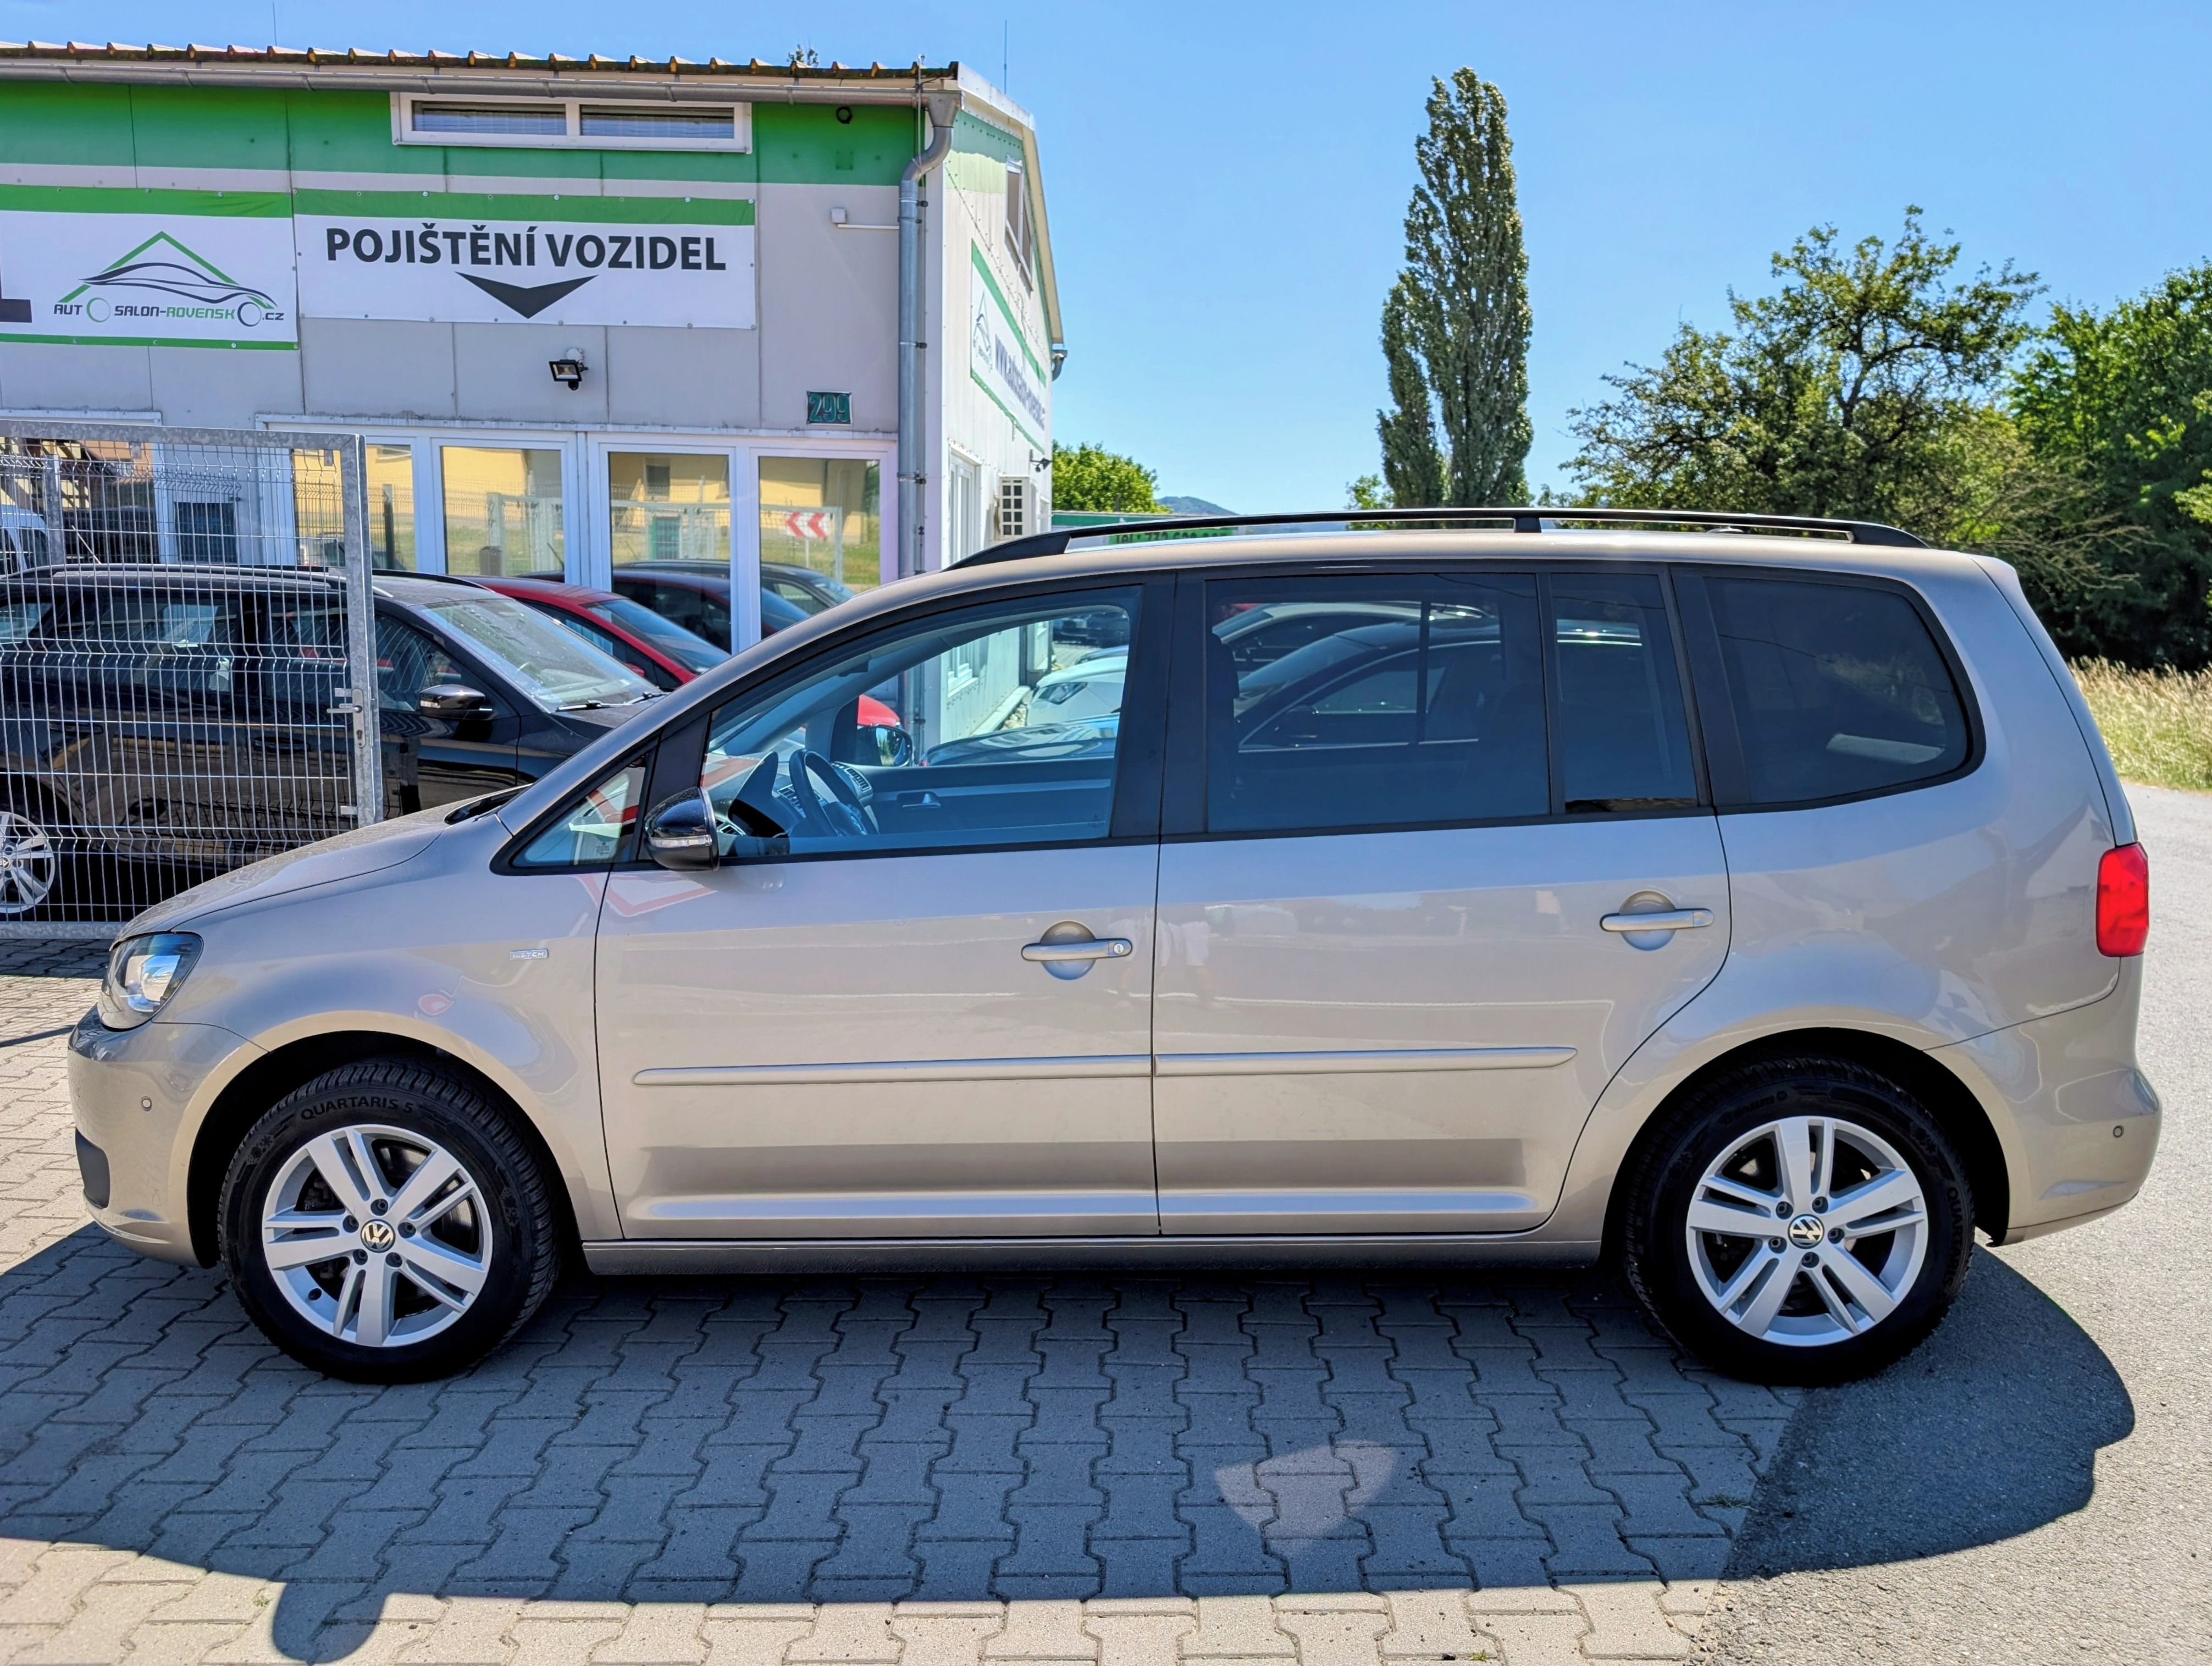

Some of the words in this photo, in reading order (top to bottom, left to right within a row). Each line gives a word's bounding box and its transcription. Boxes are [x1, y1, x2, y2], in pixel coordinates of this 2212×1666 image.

[327, 223, 538, 266] POJIŠTĚNÍ
[545, 234, 726, 271] VOZIDEL
[809, 393, 850, 422] 299
[301, 1096, 399, 1120] QUARTARIS
[403, 1102, 414, 1113] 5
[1942, 1187, 1962, 1286] QUARTARIS
